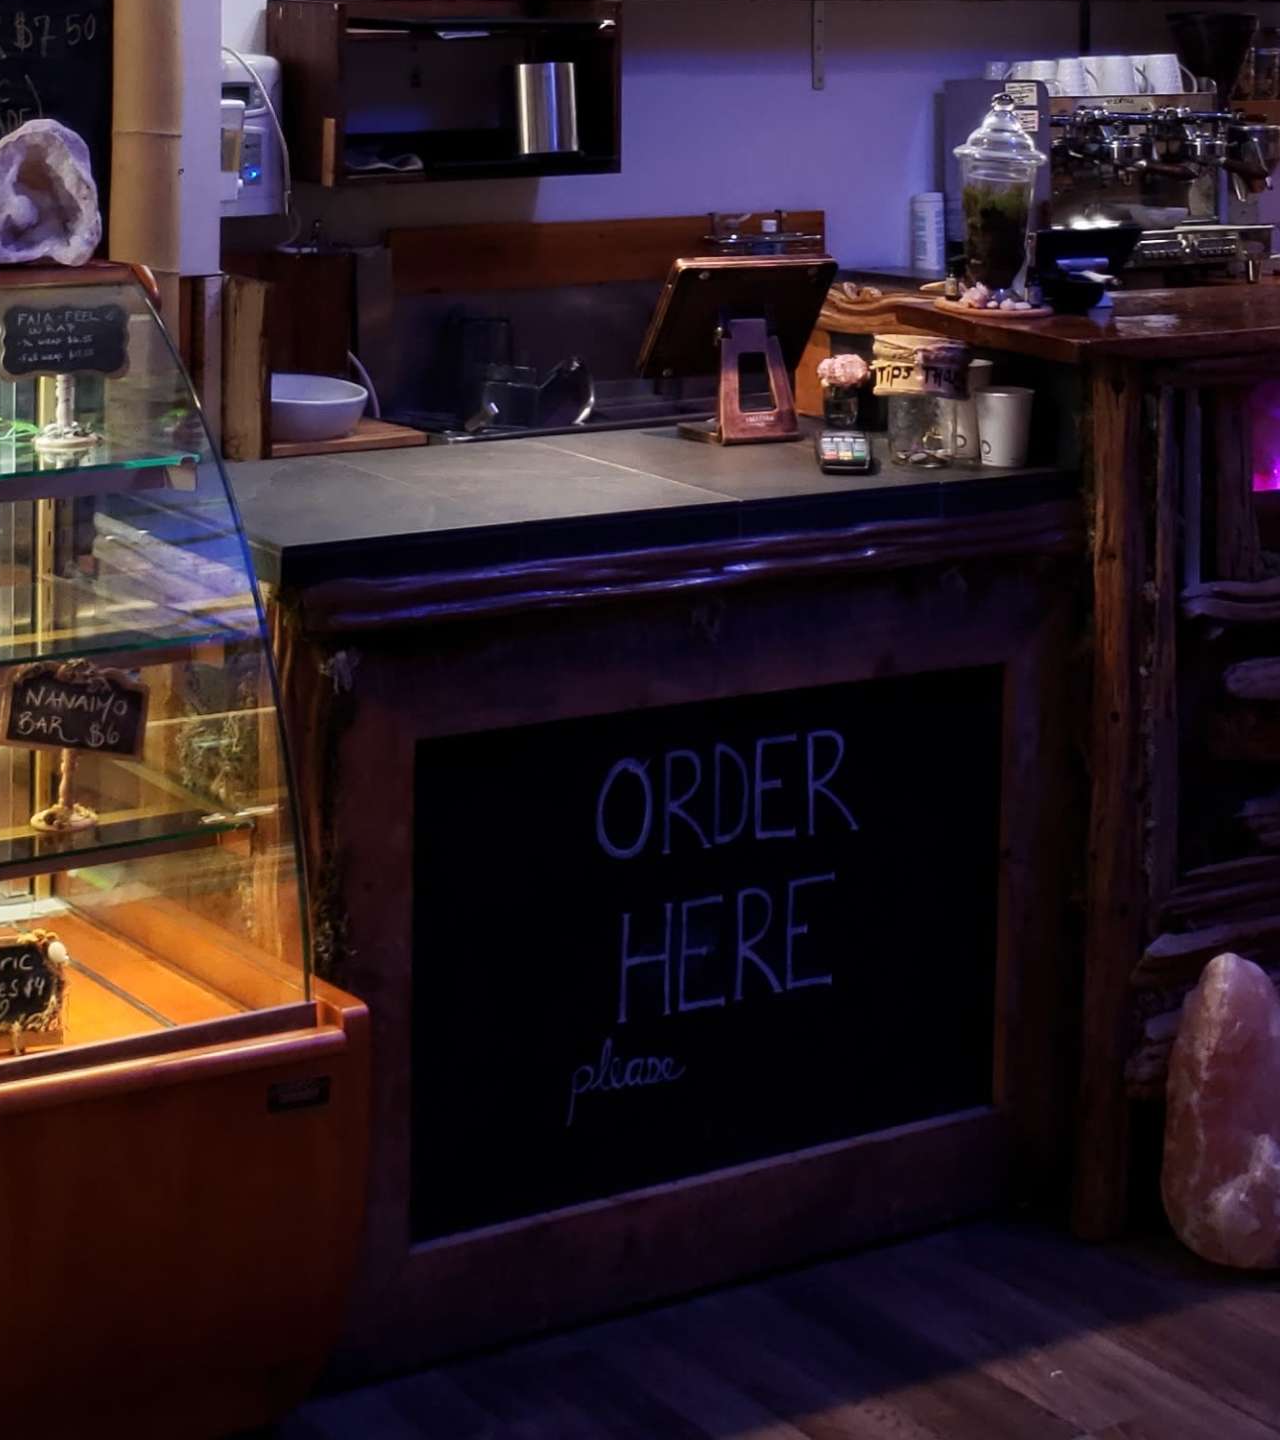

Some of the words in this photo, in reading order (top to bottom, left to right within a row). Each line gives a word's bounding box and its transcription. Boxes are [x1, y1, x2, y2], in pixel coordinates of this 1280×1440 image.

[19, 711, 78, 744] BAR
[87, 721, 120, 747] $6
[26, 686, 128, 723] NANAIMO
[596, 729, 859, 859] ORDER
[618, 872, 836, 1024] HERE
[24, 977, 45, 996] $4
[567, 1038, 686, 1127] please
